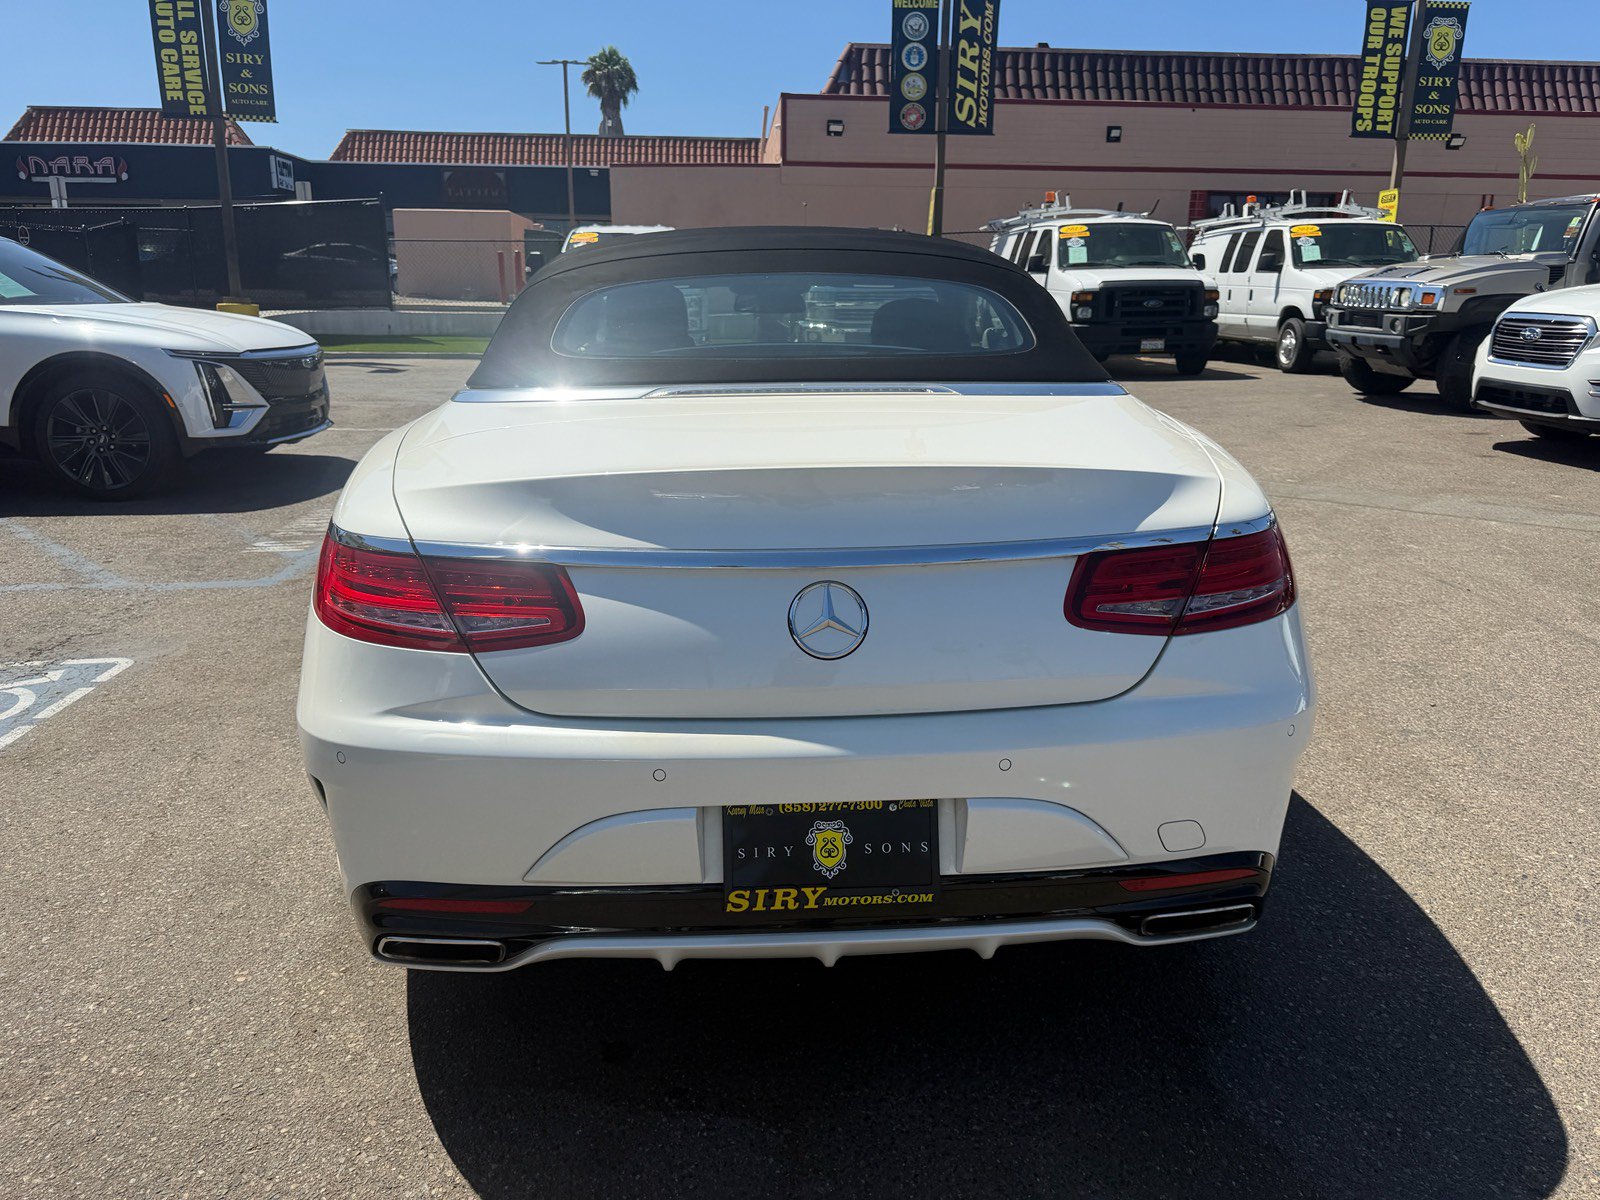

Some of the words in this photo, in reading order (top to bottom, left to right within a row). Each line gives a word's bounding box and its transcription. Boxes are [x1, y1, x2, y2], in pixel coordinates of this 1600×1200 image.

[176, 0, 195, 20] LL
[894, 0, 938, 8] WELCOME
[155, 0, 175, 43] UTO
[1367, 7, 1387, 49] OUR
[1390, 6, 1408, 38] WE
[225, 52, 264, 65] SIRY
[955, 0, 981, 128] SIRY
[978, 1, 994, 128] MOTORS.COM
[161, 48, 183, 101] CARE
[180, 30, 206, 115] SERVICE
[240, 69, 253, 79] &
[1418, 77, 1454, 87] SIRY
[228, 82, 268, 95] SONS
[1355, 53, 1380, 131] TROOPS
[1376, 43, 1402, 134] SUPPORT
[1428, 90, 1440, 100] &
[1414, 104, 1450, 115] SONS
[778, 802, 816, 815] (858)
[818, 801, 882, 811] 277-7300
[737, 845, 795, 859] SIRY
[864, 841, 929, 854] SONS
